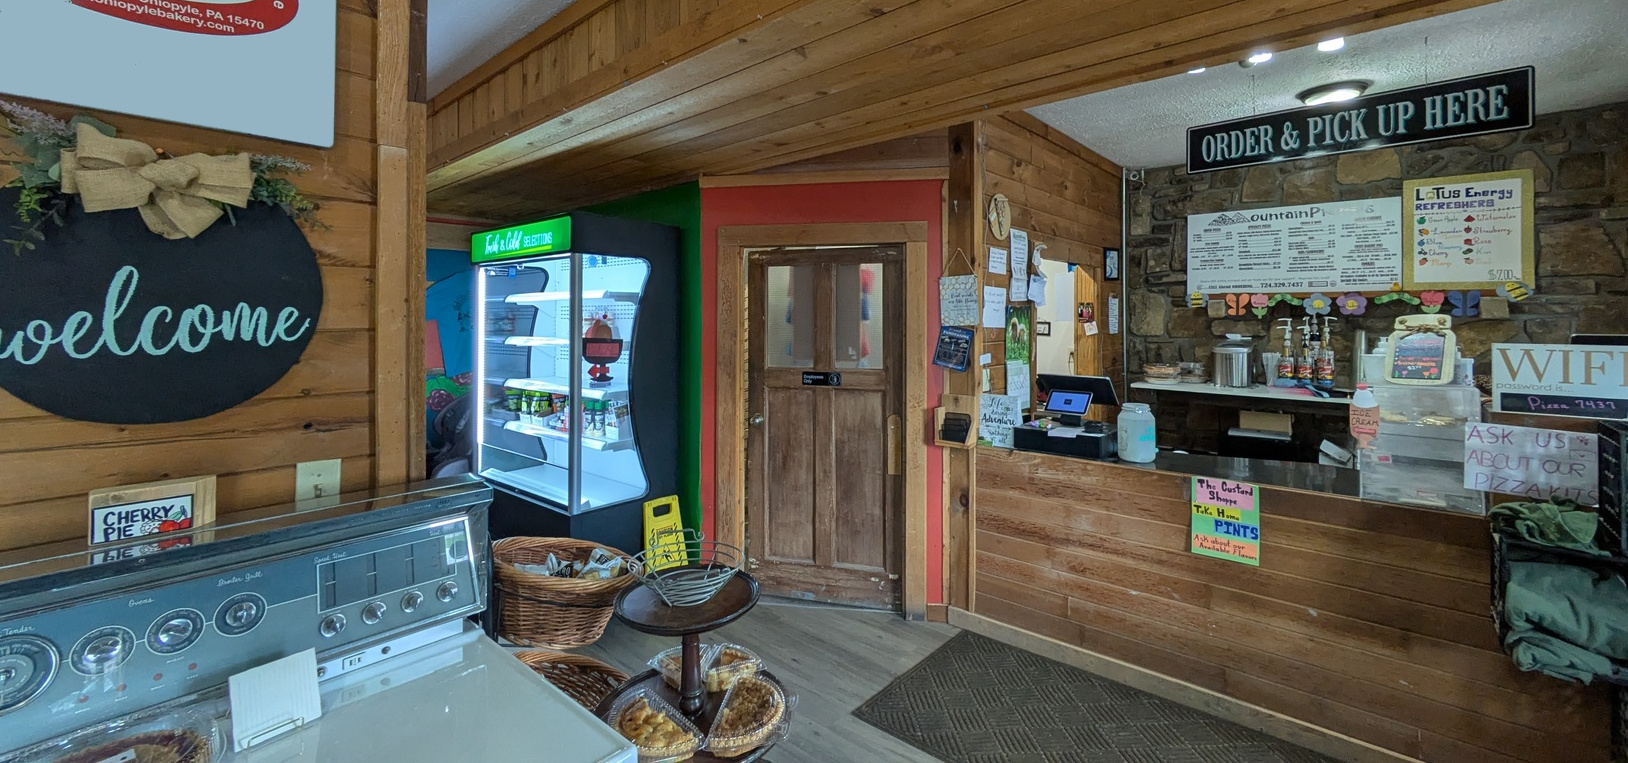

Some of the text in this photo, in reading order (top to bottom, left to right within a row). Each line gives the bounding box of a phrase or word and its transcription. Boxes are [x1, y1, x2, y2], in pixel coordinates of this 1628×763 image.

[206, 9, 224, 21] PA
[227, 14, 264, 30] 15470
[1201, 83, 1511, 163] ORDER & PICK UP HERE
[1415, 199, 1495, 212] REFRESHERS
[1476, 213, 1516, 222] Watermelon
[1473, 226, 1513, 237] Strawberry
[500, 240, 505, 251] &
[505, 230, 523, 251] Cold
[523, 232, 553, 248] SELECTIONS
[1473, 236, 1493, 245] Rose
[1429, 249, 1449, 259] Cherry
[1260, 281, 1303, 289] 724.329.7437
[0, 265, 310, 365] welcome
[1496, 382, 1552, 393] password
[1527, 396, 1616, 411] Pizza 7437
[981, 413, 1017, 426] Adventure
[1350, 409, 1372, 418] ICE
[1351, 416, 1379, 427] CREAM
[1467, 425, 1567, 450] ASK US
[1466, 449, 1586, 479] ABOUT OUR
[1197, 478, 1253, 497] The Custard
[1474, 472, 1541, 498] PIZZA
[1209, 490, 1237, 506] Shoppe
[103, 504, 175, 527] CHERRY
[1217, 508, 1240, 521] Home
[103, 524, 135, 543] PIE
[1214, 519, 1259, 541] PINTS
[1210, 537, 1231, 548] about
[244, 570, 264, 582] Grill
[2, 625, 37, 636] Tender
